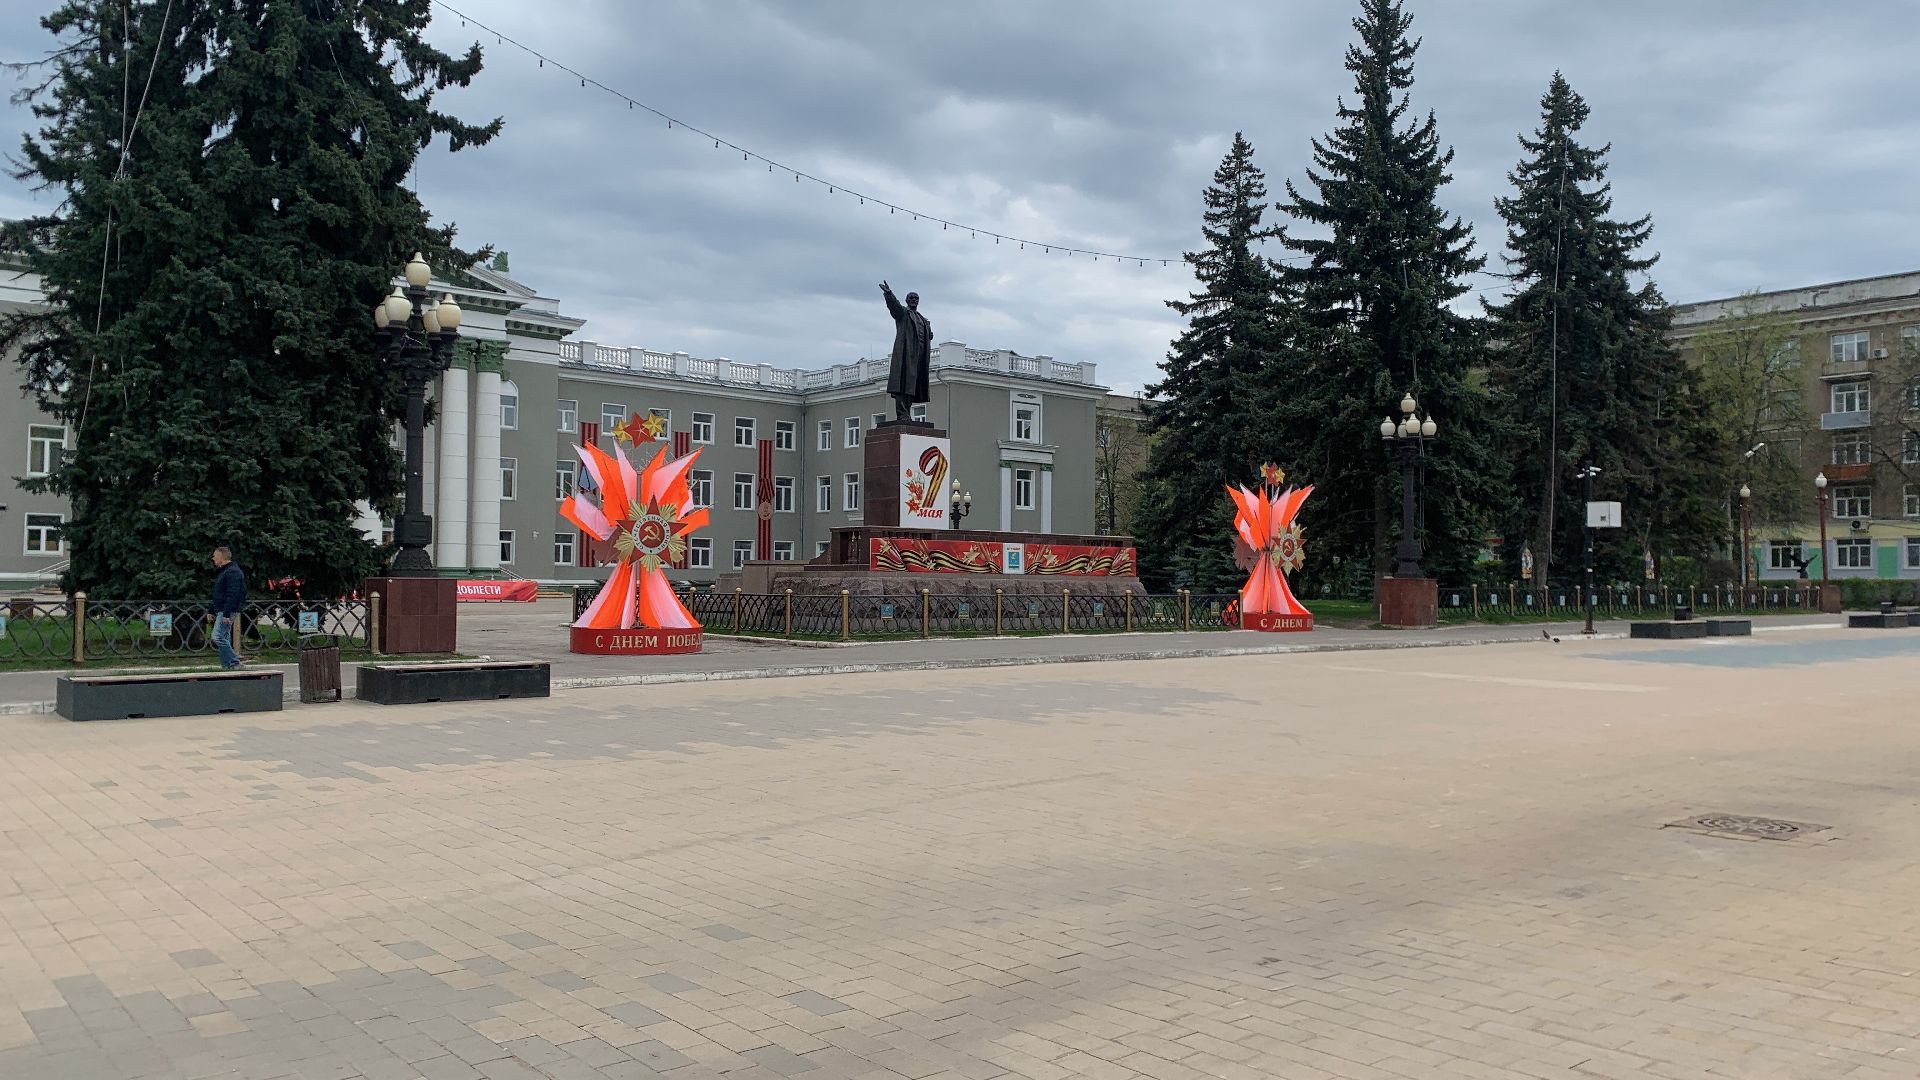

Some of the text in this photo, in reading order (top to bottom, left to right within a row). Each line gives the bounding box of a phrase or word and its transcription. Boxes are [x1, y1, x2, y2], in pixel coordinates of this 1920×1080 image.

[918, 446, 948, 508] 9
[917, 508, 943, 518] мая
[1272, 618, 1302, 629] ДНЕМ
[595, 635, 604, 648] С
[609, 635, 658, 650] ДНЕМ
